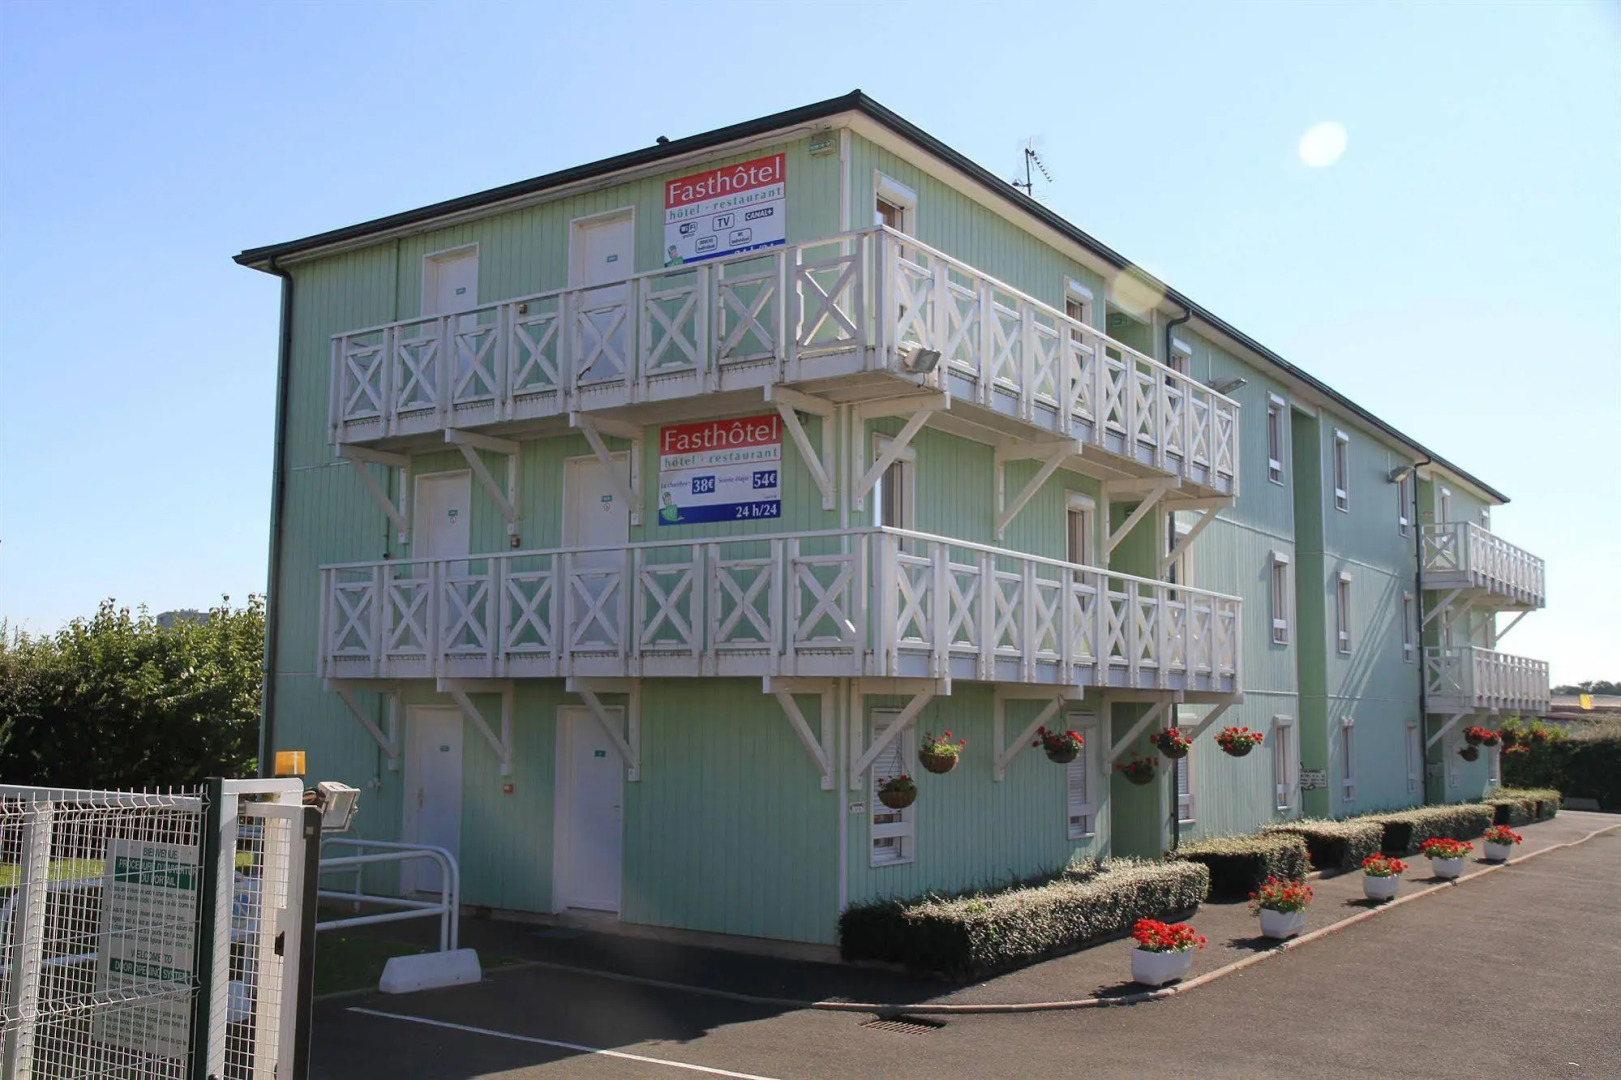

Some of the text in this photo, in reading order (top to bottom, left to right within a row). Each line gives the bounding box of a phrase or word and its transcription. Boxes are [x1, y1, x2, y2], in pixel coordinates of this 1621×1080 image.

[670, 156, 780, 204] Fasthôtel
[669, 204, 700, 220] hôtel
[713, 187, 781, 210] restaurant
[746, 208, 773, 220] CANAL+
[717, 216, 730, 228] TV
[665, 416, 777, 451] Fasthôtel
[664, 455, 696, 468] hôtel
[709, 447, 778, 463] restaurant
[693, 478, 714, 493] 38€
[754, 473, 776, 488] 54€
[736, 504, 777, 518] 24 h/24
[119, 859, 155, 871] PROCEUR
[164, 954, 173, 964] TO
